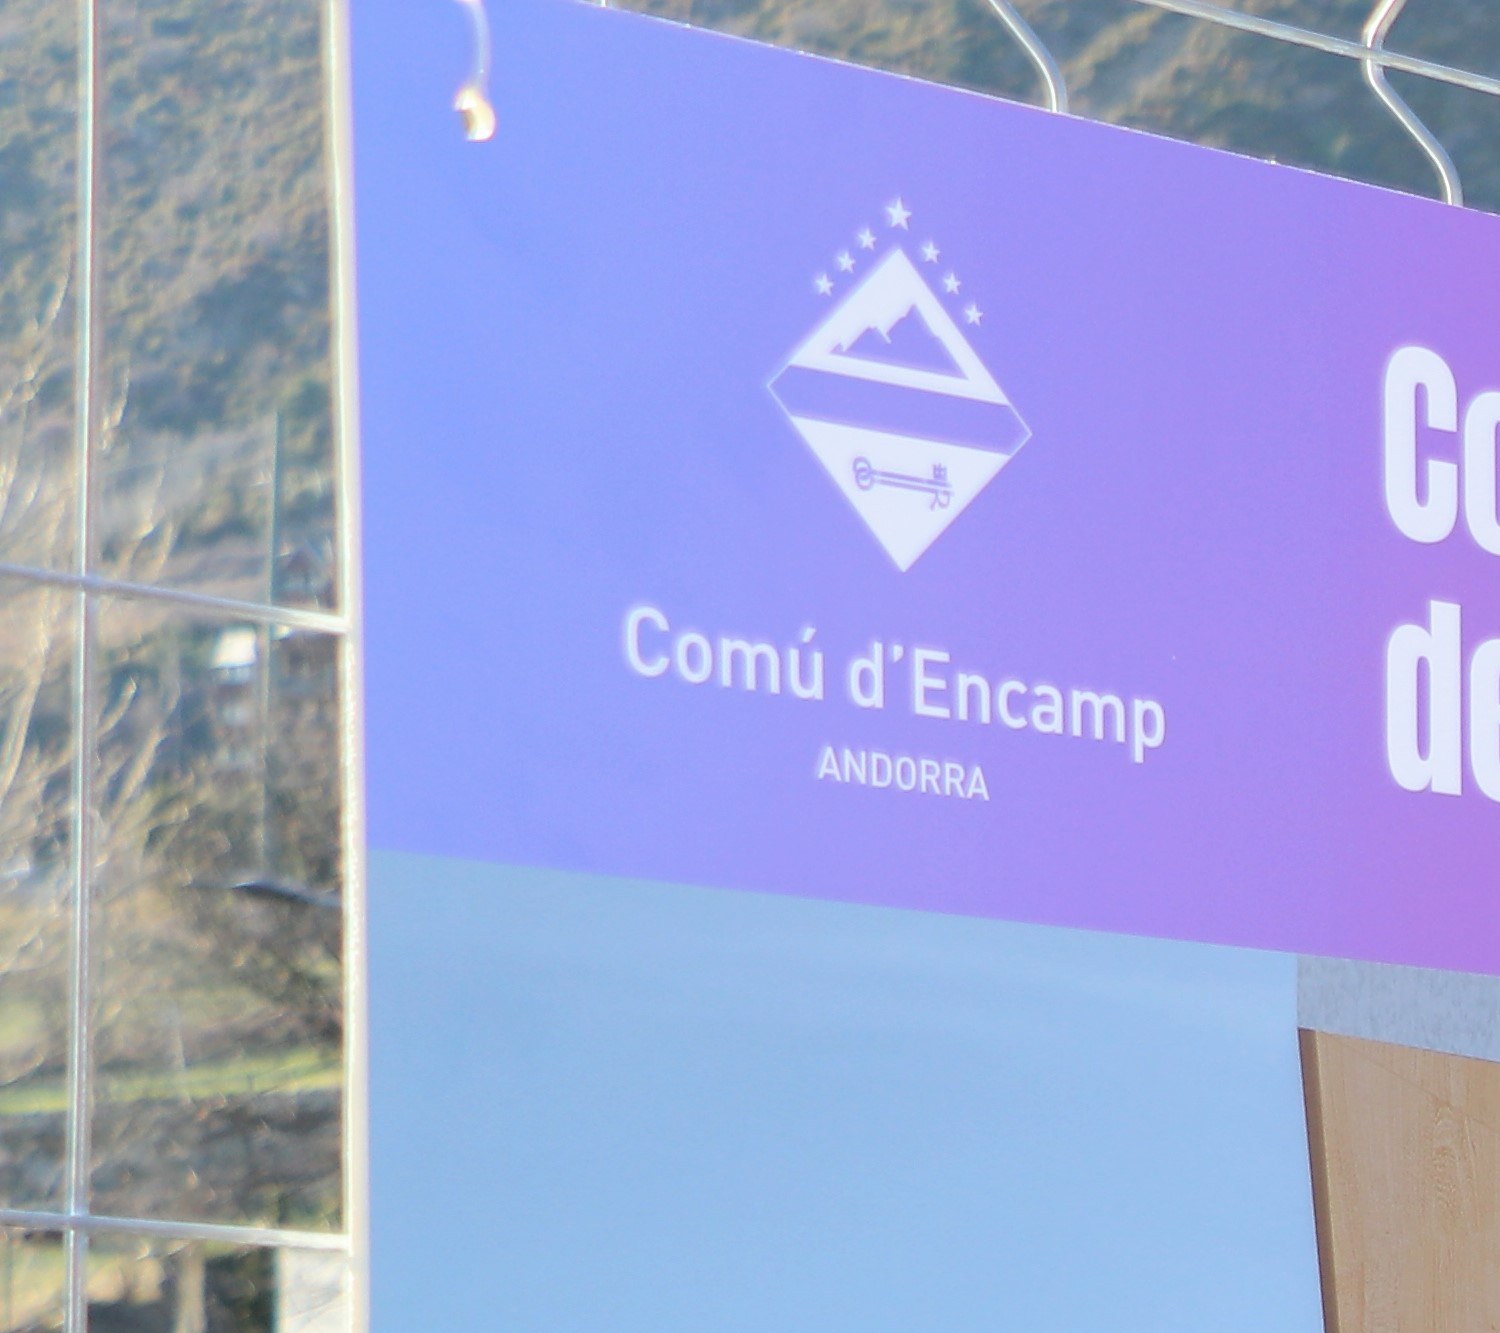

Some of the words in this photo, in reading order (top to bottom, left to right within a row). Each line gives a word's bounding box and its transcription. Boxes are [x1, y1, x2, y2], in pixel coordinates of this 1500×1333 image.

[620, 601, 824, 701] Comú
[845, 639, 1165, 764] d'Encamp
[814, 744, 990, 801] ANDORRA
